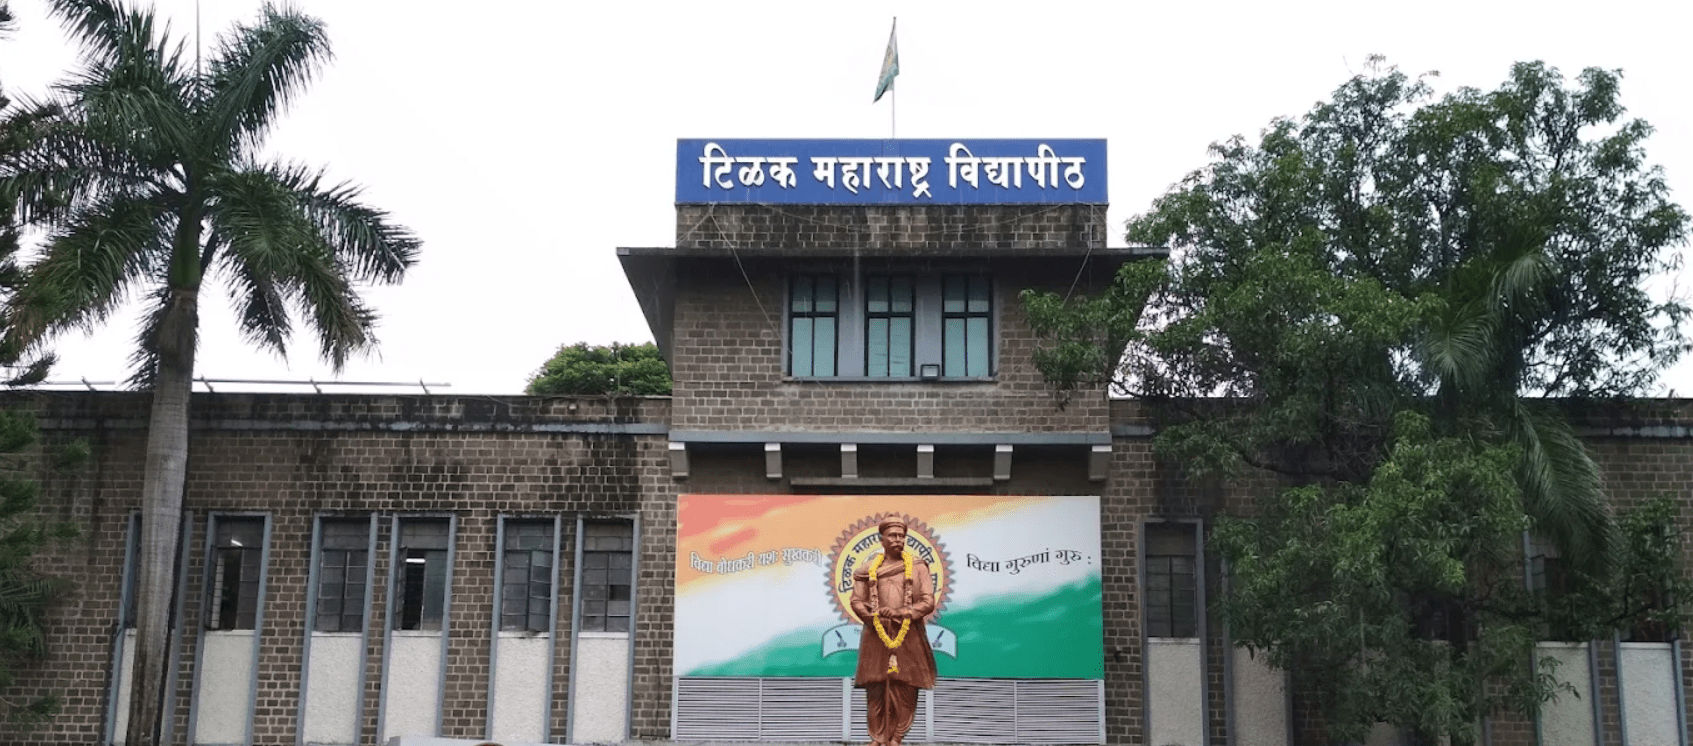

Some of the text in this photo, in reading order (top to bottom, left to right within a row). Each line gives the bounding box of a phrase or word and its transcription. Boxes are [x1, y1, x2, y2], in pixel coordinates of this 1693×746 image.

[699, 142, 1087, 198] टिळक महाराष्ट्र विद्यापीठ
[966, 552, 1000, 573] विद्या
